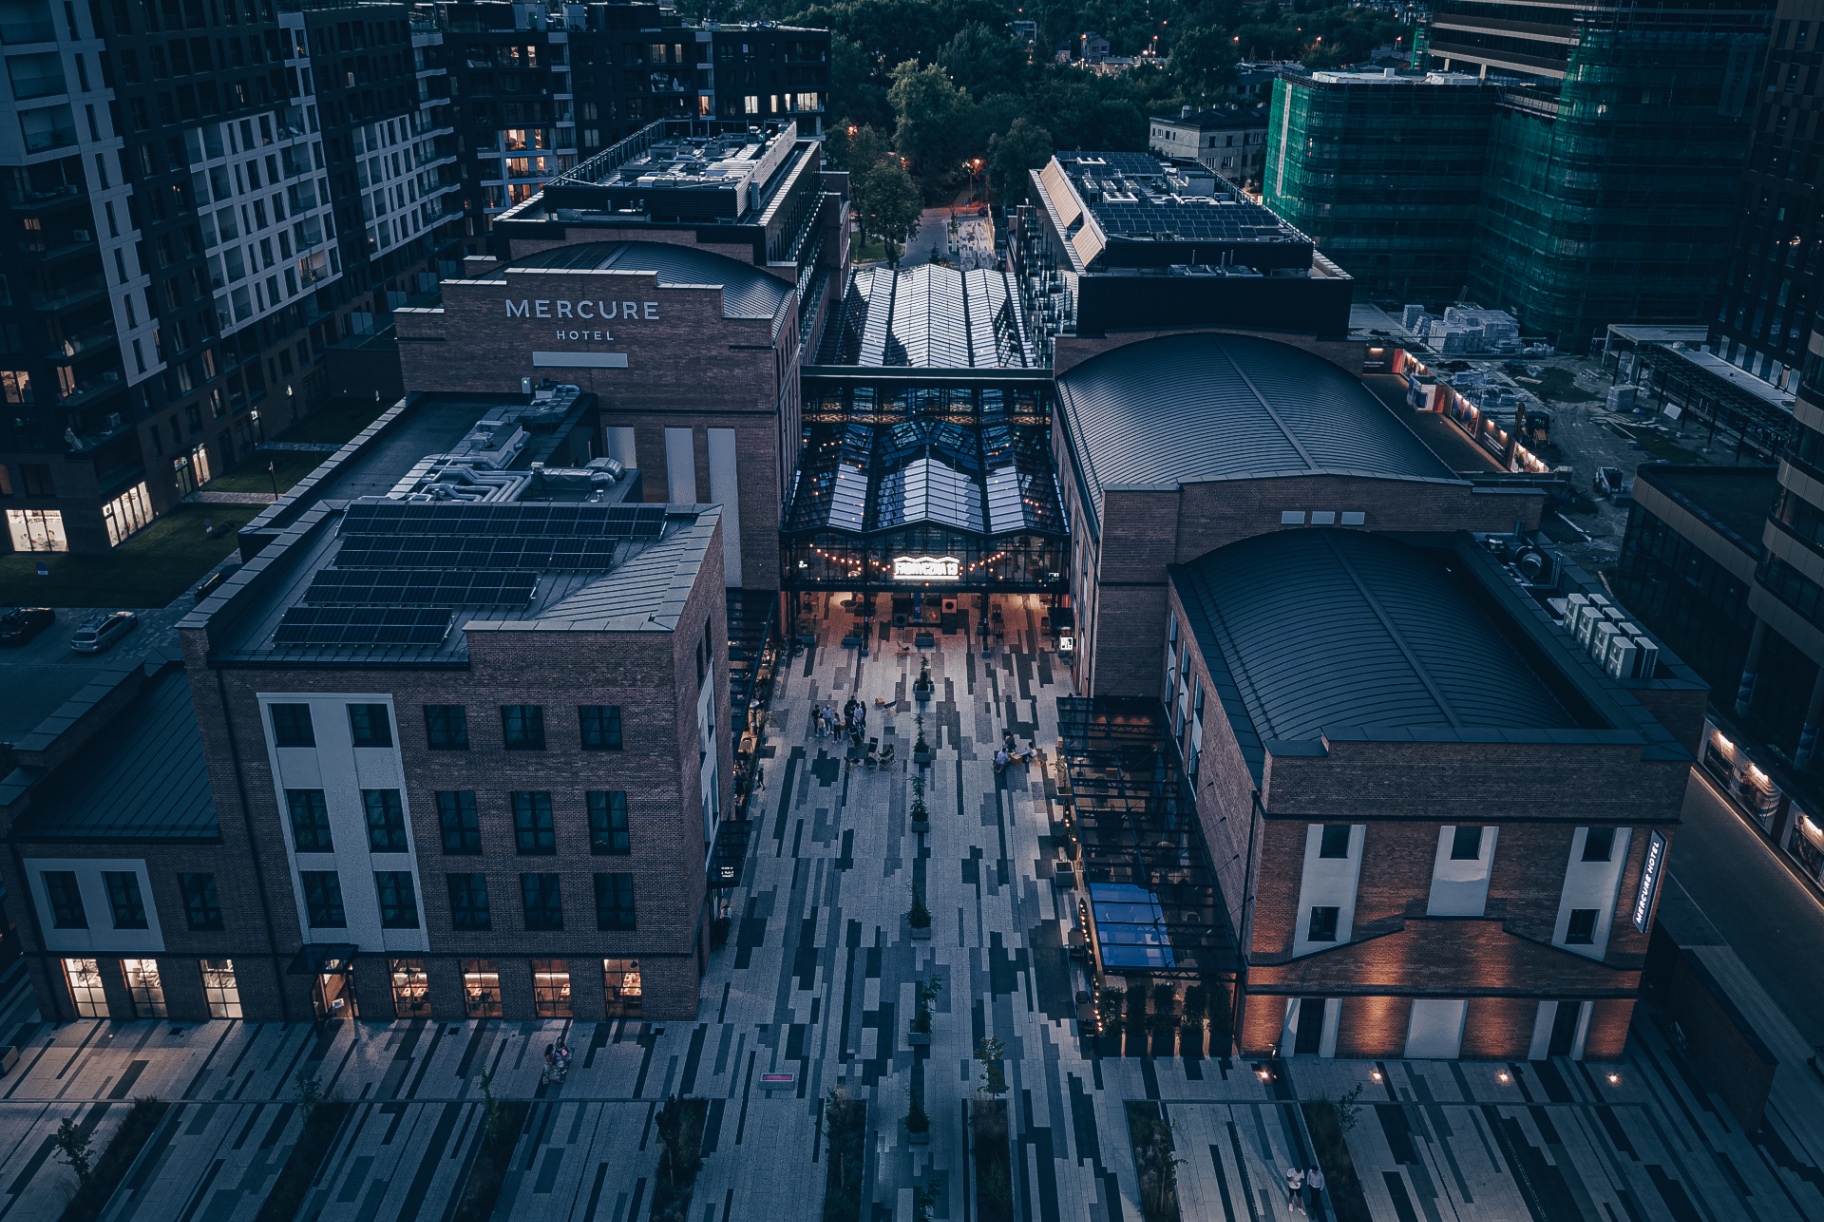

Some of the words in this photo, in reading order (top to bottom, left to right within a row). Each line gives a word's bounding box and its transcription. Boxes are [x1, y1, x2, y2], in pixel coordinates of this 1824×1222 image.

[505, 299, 660, 320] MERCURE
[556, 330, 614, 341] HOTEL
[1635, 873, 1652, 924] MERCURE
[1647, 841, 1660, 874] HOTEL
